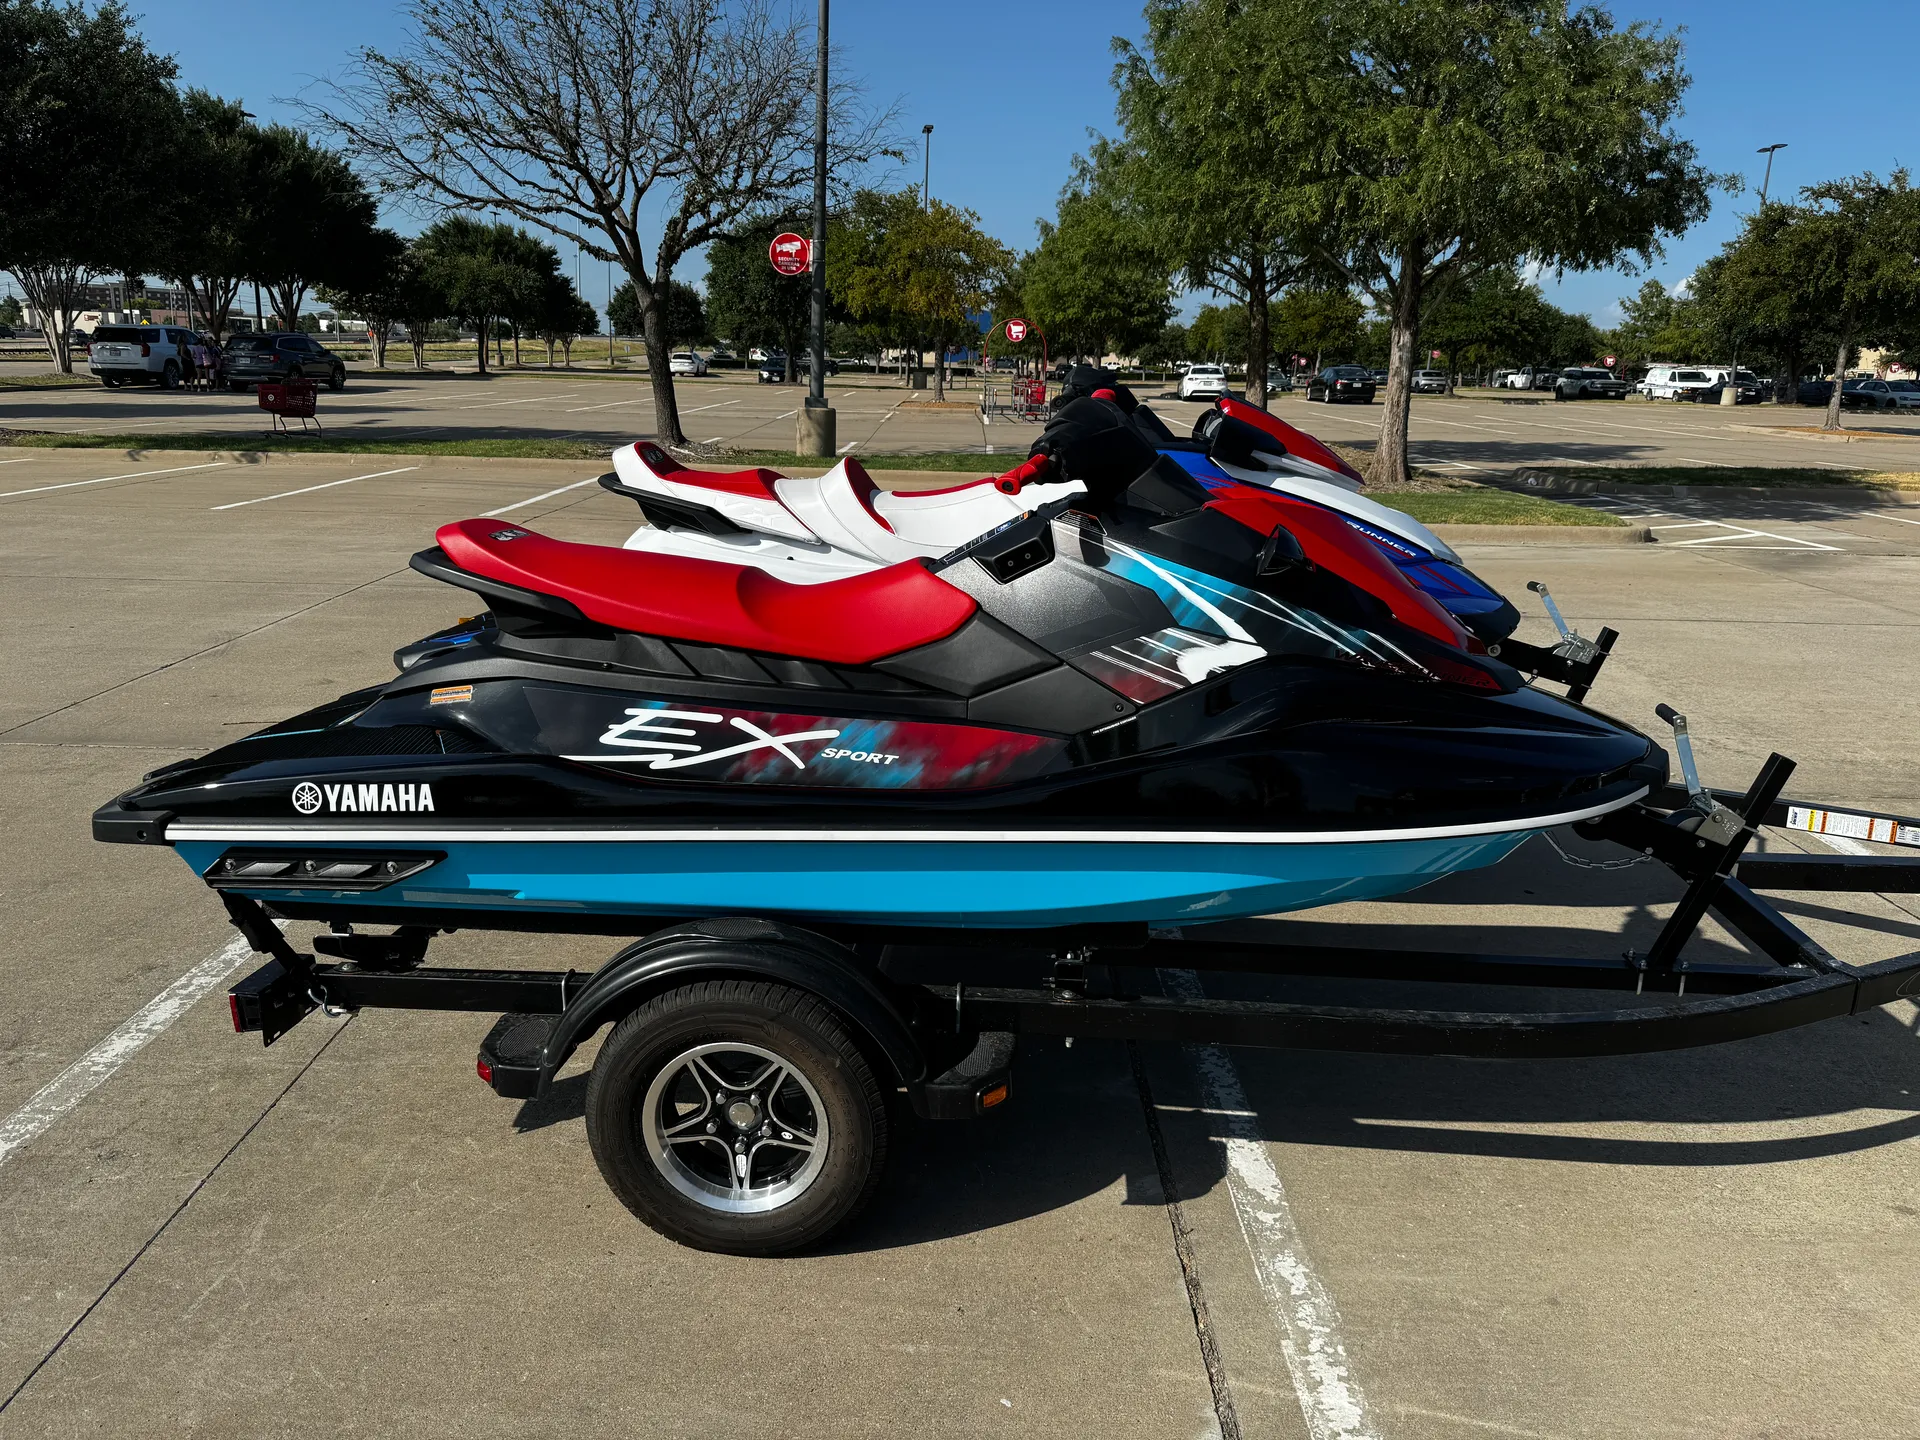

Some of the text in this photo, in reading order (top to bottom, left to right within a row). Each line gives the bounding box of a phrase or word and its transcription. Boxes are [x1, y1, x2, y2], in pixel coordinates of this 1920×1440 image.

[559, 707, 840, 769] EX
[821, 748, 899, 765] SPORT
[323, 783, 435, 812] YAMAHA
